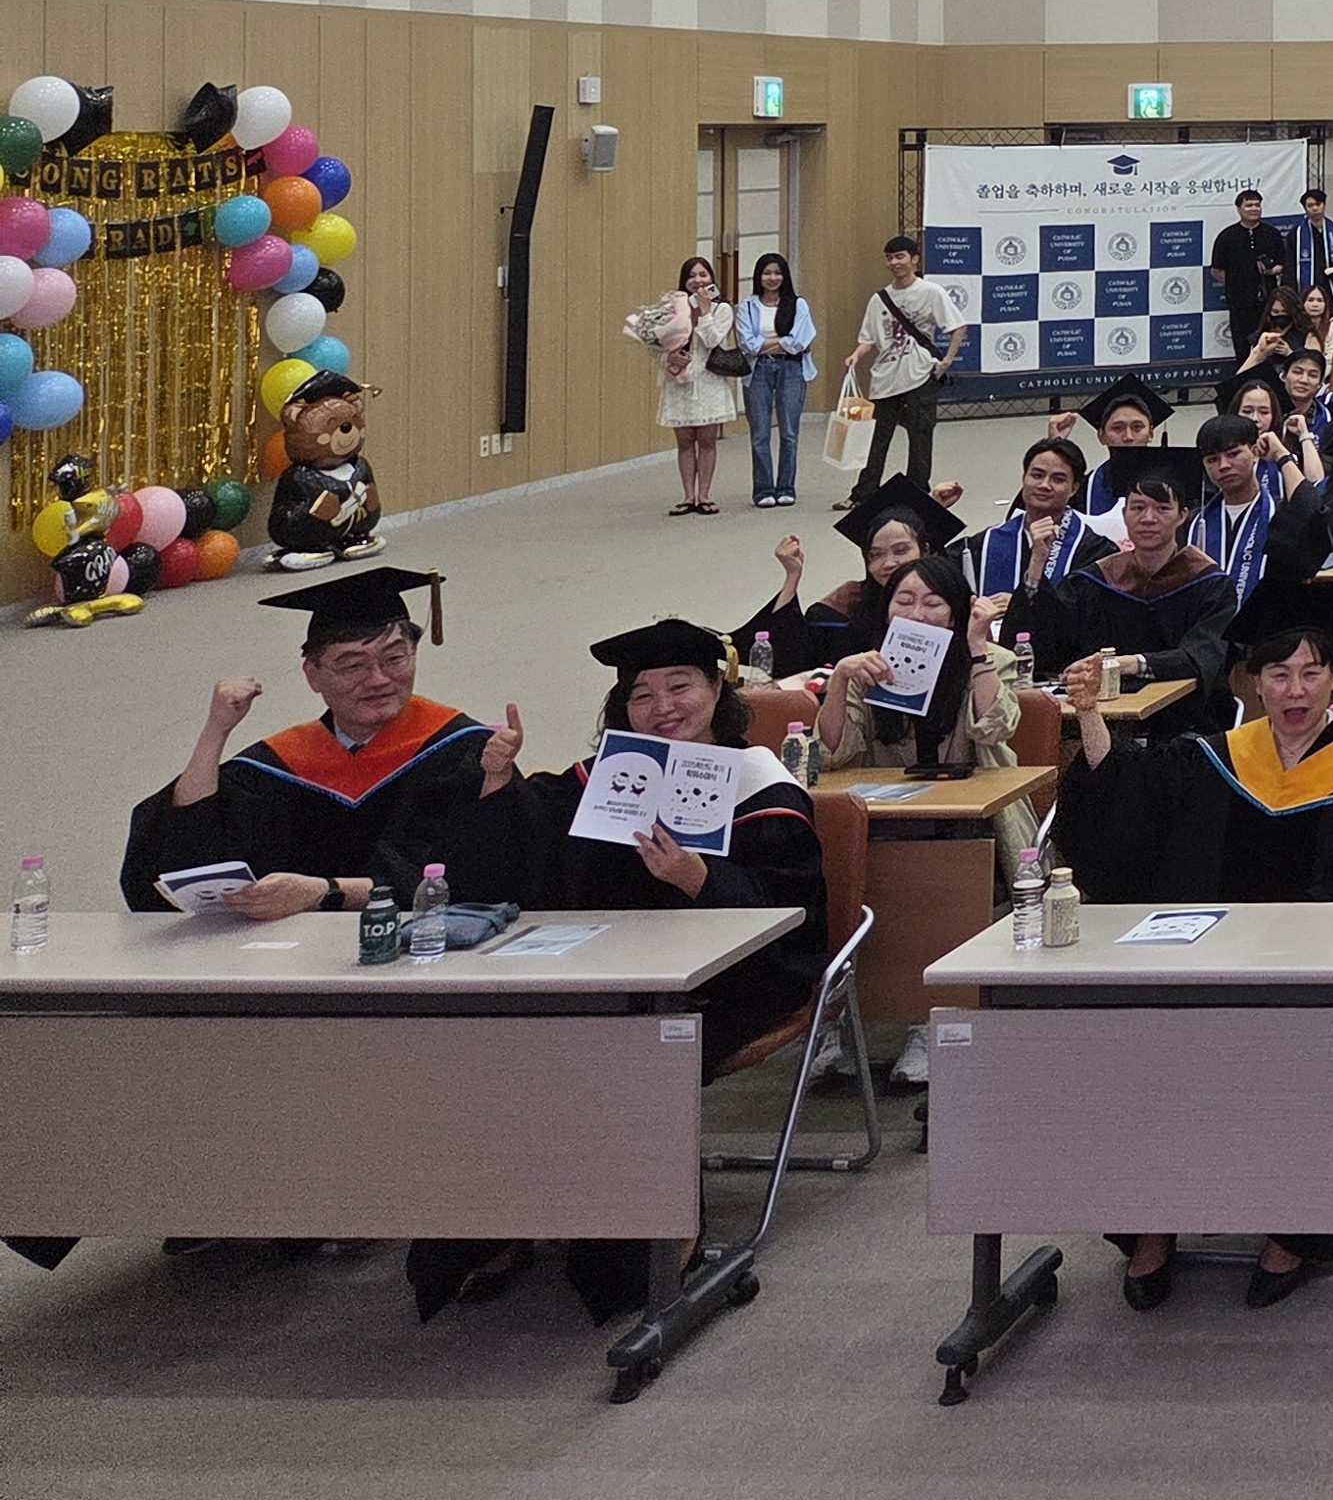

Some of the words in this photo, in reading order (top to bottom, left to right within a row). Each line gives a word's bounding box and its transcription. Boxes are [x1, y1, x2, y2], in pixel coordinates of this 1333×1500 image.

[15, 155, 237, 192] ONGRATS
[976, 183, 1021, 199] 졸업을
[1092, 181, 1136, 197] 새로운
[1140, 180, 1181, 196] 시작을
[1185, 177, 1261, 195] 응원합니다!
[1067, 205, 1178, 215] CONGRATULATION
[1019, 377, 1082, 389] CATHOLIC
[1086, 373, 1160, 384] UNIVITY
[1164, 370, 1178, 380] OF
[1183, 368, 1221, 378] PUSAN
[363, 921, 395, 937] T.O.P
